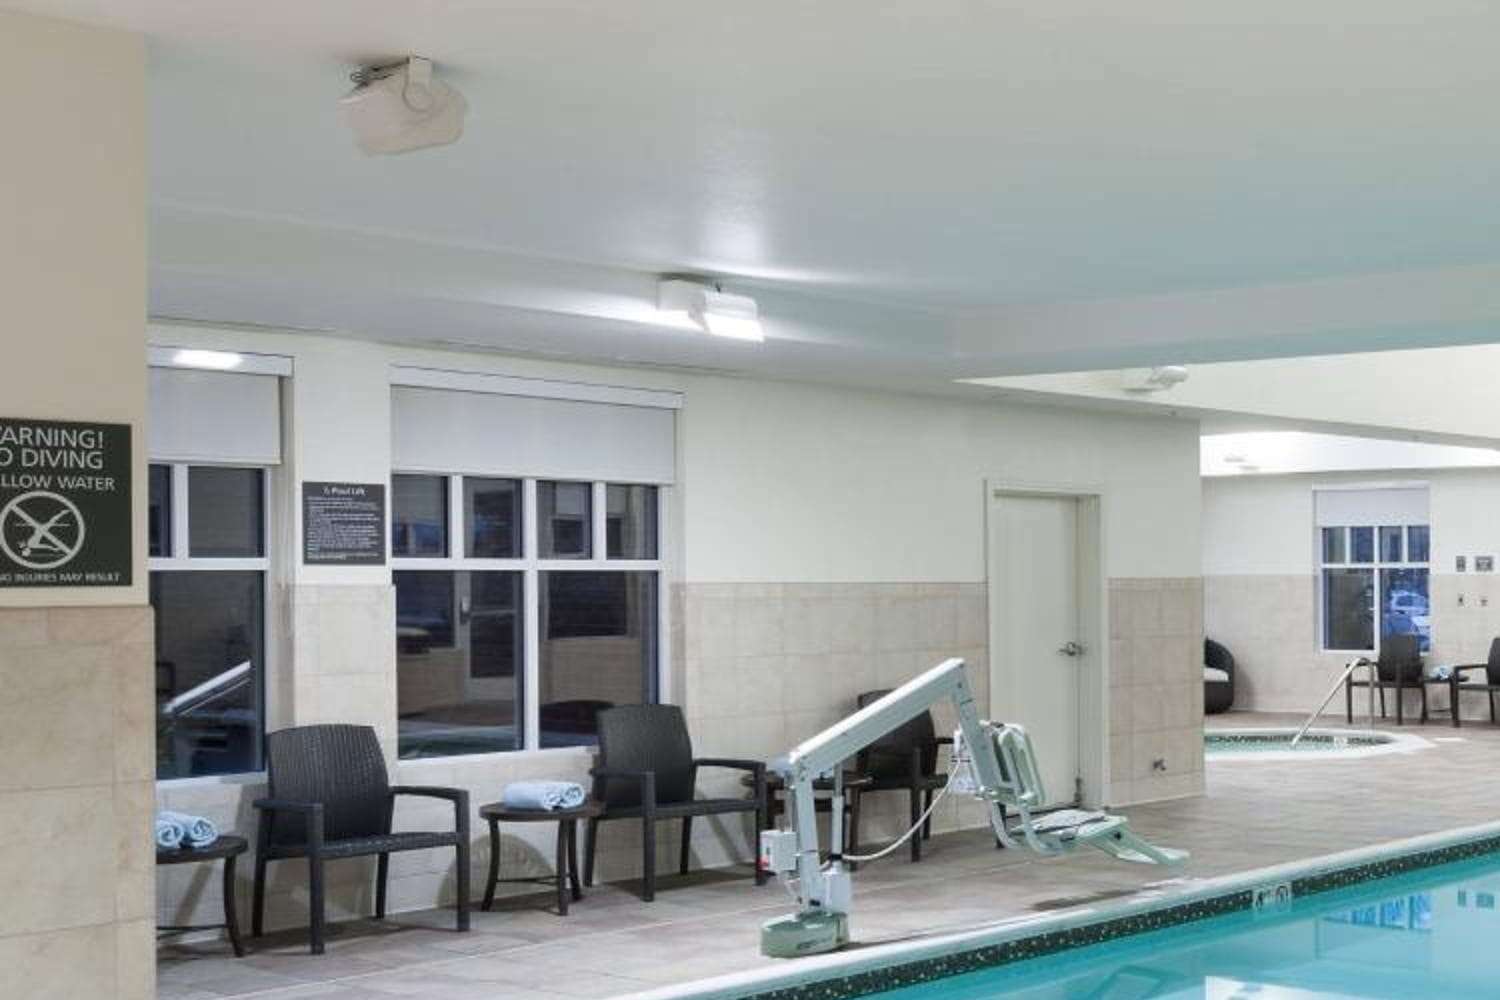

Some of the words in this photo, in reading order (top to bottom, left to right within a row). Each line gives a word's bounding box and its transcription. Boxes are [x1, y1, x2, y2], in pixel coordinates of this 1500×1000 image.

[0, 426, 104, 449] ARNING!
[0, 447, 13, 467] O
[21, 447, 104, 470] DIVING
[1, 473, 51, 489] LLOW
[57, 475, 116, 490] WATER
